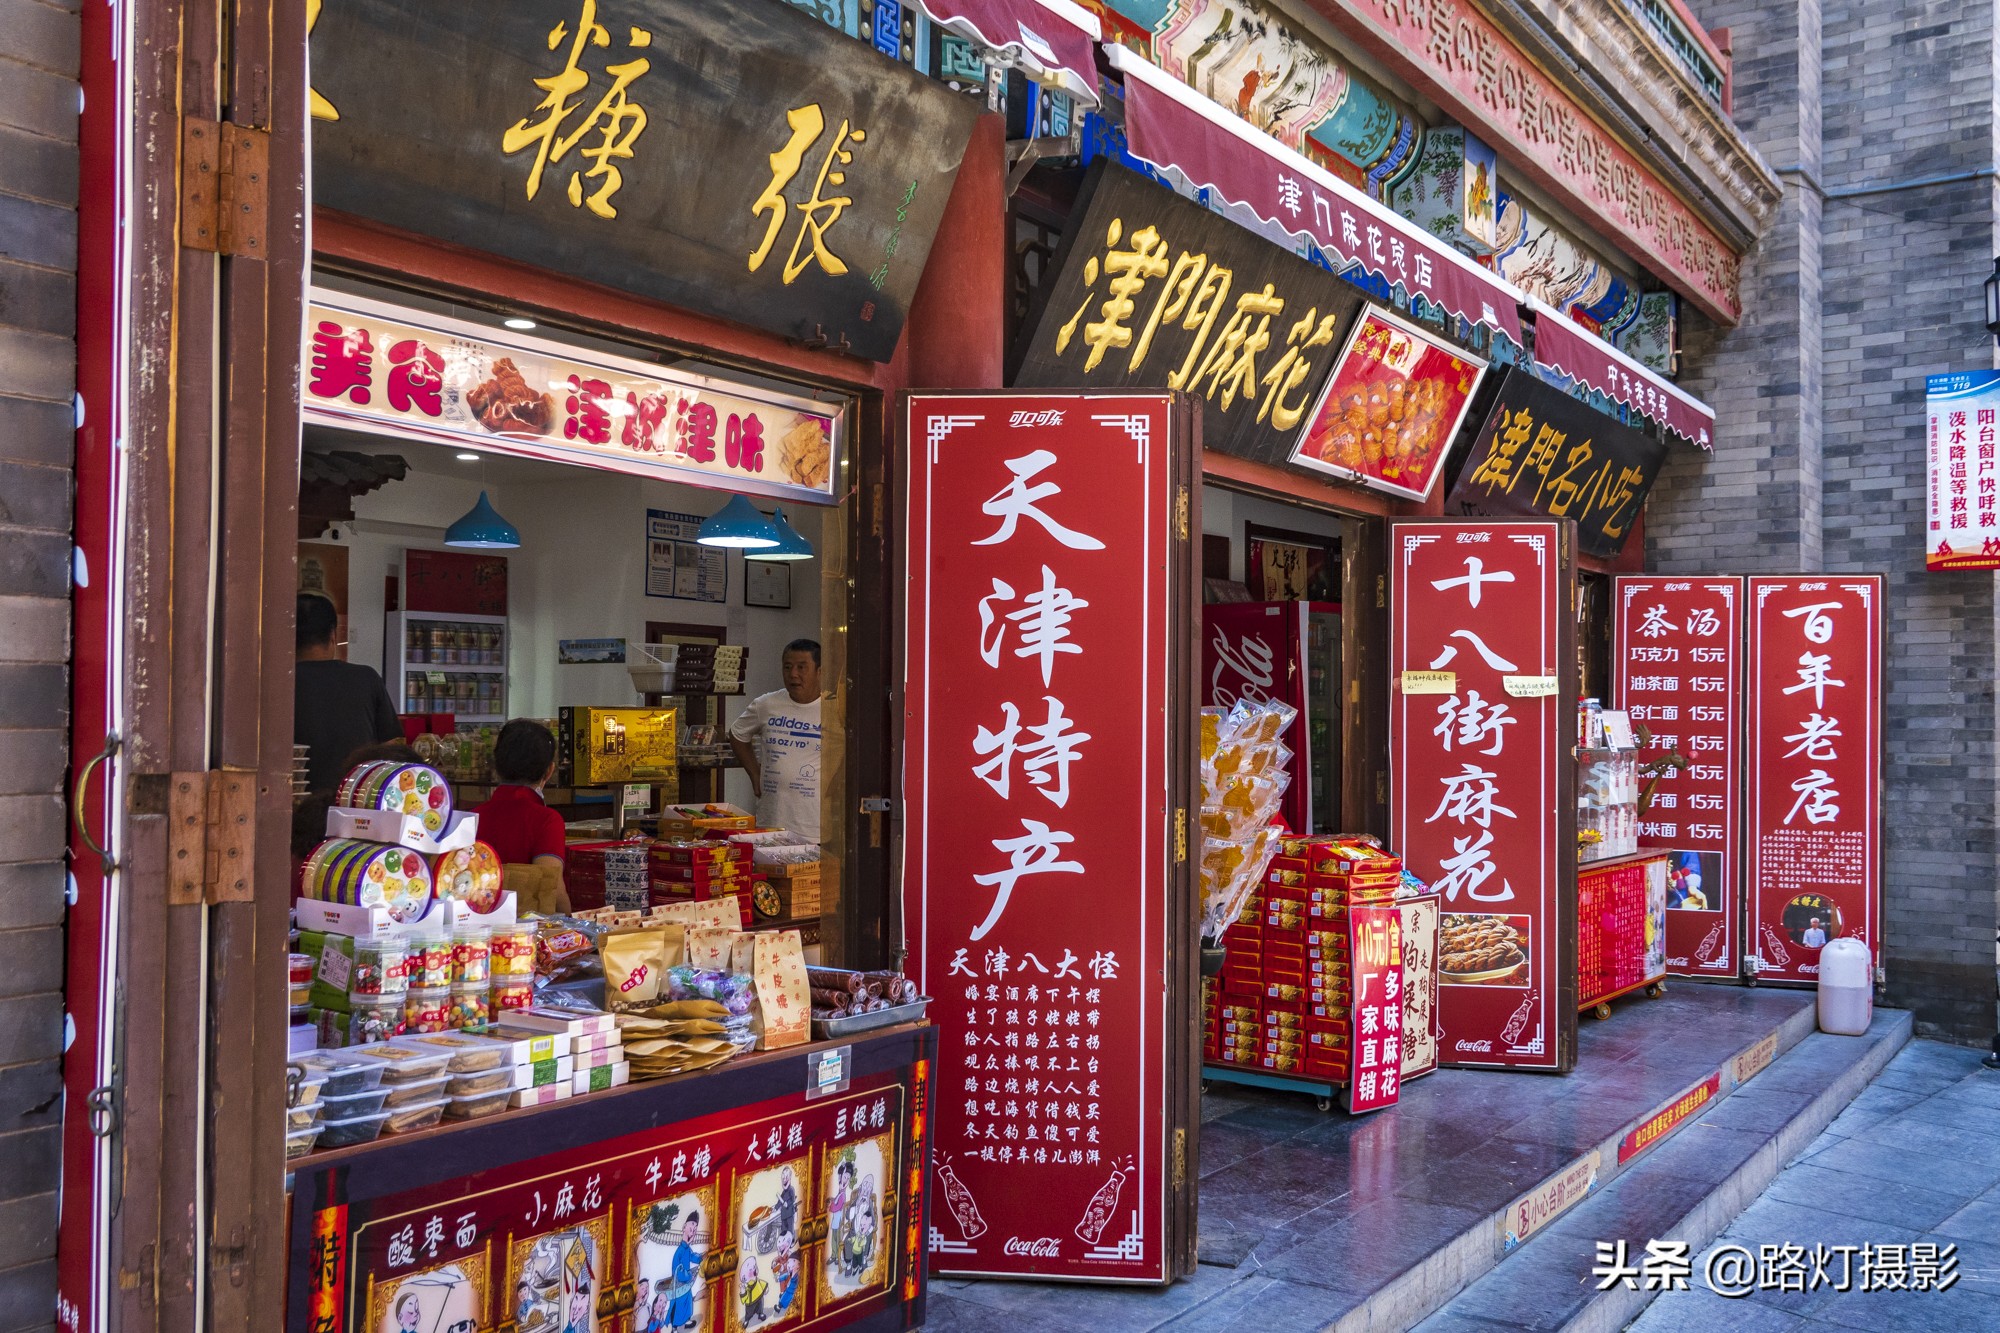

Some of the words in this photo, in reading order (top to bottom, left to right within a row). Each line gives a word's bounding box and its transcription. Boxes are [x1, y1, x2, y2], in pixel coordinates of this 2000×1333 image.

[1953, 381, 1970, 391] 119
[1009, 409, 1066, 428] 可口可乐
[1949, 411, 1968, 529] 泼水降温等救援
[1978, 408, 1996, 528] 阳台窗户快呼救
[1456, 532, 1493, 544] 可口可乐
[1635, 603, 1721, 640] 茶汤
[1630, 647, 1678, 662] 巧克力
[1688, 648, 1725, 663] 15元
[1630, 676, 1678, 691] 油茶面
[1688, 677, 1725, 692] 15元
[970, 449, 1106, 941] 天津特产
[768, 716, 810, 730] adidas
[1630, 705, 1678, 720] 杏仁面
[1688, 706, 1725, 721] 15元
[1781, 601, 1846, 825] 百年老店
[1424, 556, 1518, 902] 十八街麻花
[1688, 736, 1725, 751] 15元
[1688, 766, 1725, 781] 15元
[1635, 794, 1678, 809] 子面
[1688, 795, 1725, 810] 15元
[1688, 824, 1725, 839] 15元
[1358, 916, 1400, 966] 10元/盒
[948, 945, 1120, 981] 天津八大怪
[965, 984, 1101, 1004] 婚宴酒席下午摆
[966, 1007, 1101, 1028] 生了孩子姥姥带
[965, 1031, 1100, 1050] 给人指路左右拐
[1359, 973, 1379, 1101] 厂家直销
[1380, 970, 1400, 1097] 多味麻花
[965, 1053, 1100, 1074] 观众捧哏不上台
[965, 1077, 1100, 1097] 路边烧烤人人爱
[834, 1097, 886, 1141] 豆根糖
[965, 1099, 1100, 1121] 想吃海货借钱买
[744, 1121, 803, 1165] 大梨糕
[964, 1122, 1100, 1143] 冬天钓鱼傻可爱
[964, 1146, 1101, 1167] 一提停车倍儿澎湃
[644, 1143, 713, 1195] 牛皮糖
[525, 1172, 603, 1228] 小麻花
[1531, 1180, 1566, 1224] 小心台阶
[387, 1211, 477, 1268] 酸枣面
